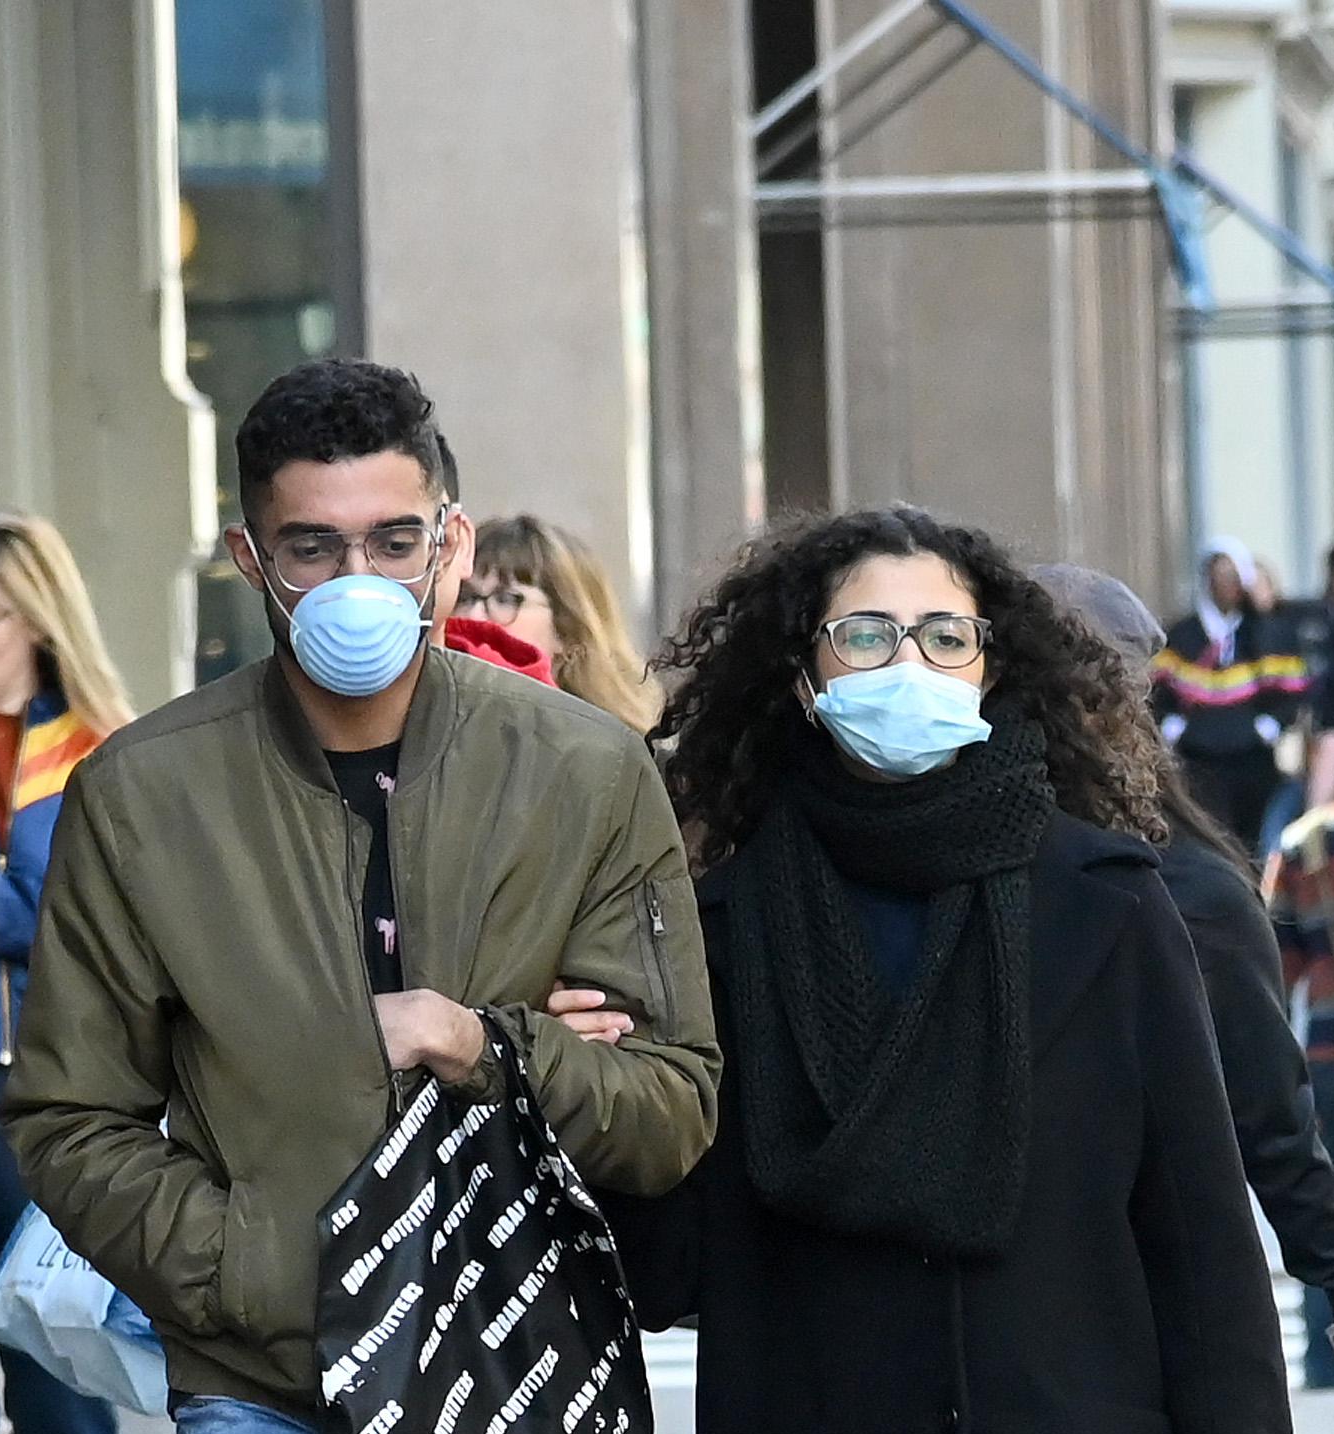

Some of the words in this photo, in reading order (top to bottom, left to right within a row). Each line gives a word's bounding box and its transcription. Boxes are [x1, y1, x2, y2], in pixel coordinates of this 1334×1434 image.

[341, 1246, 384, 1295] URBAN
[351, 1282, 423, 1362] OUTFITTERS
[480, 1296, 526, 1349] URBAN
